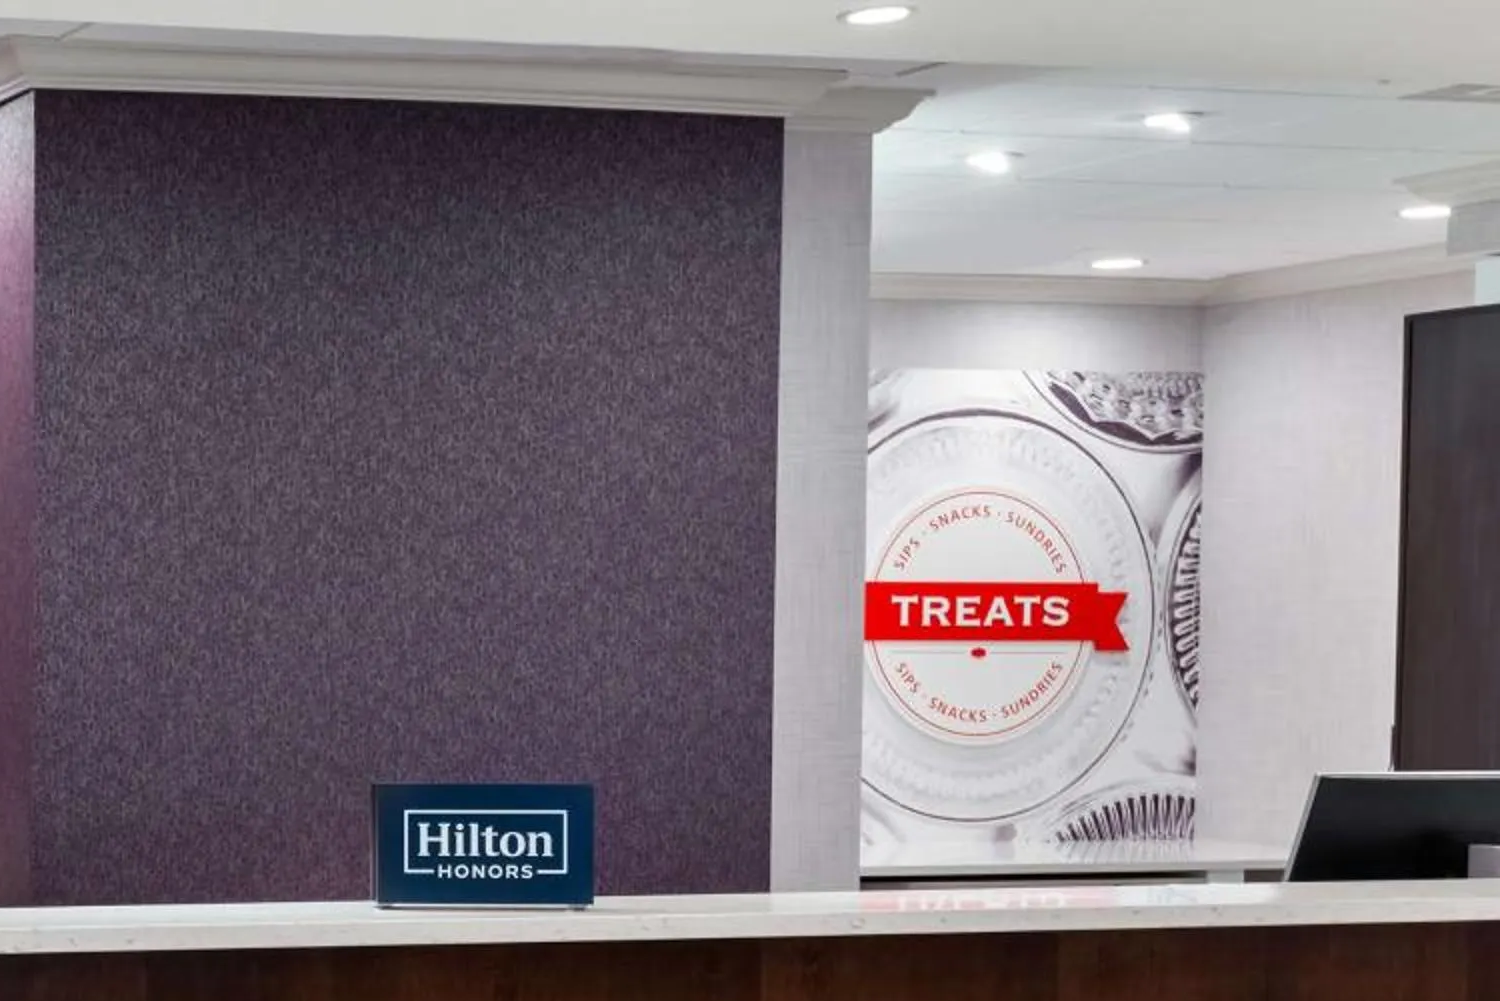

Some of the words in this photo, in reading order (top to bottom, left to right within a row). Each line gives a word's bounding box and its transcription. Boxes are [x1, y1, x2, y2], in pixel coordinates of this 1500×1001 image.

[894, 537, 921, 570] SIPS
[928, 505, 991, 531] SNACKS
[1005, 511, 1067, 573] SUNDRIES
[891, 594, 1070, 627] TREATS
[896, 662, 918, 694] SIPS
[929, 696, 987, 723] SNACKS
[1001, 662, 1063, 719] SUNDRIES
[417, 822, 554, 857] Hilton
[437, 864, 533, 879] HONORS
